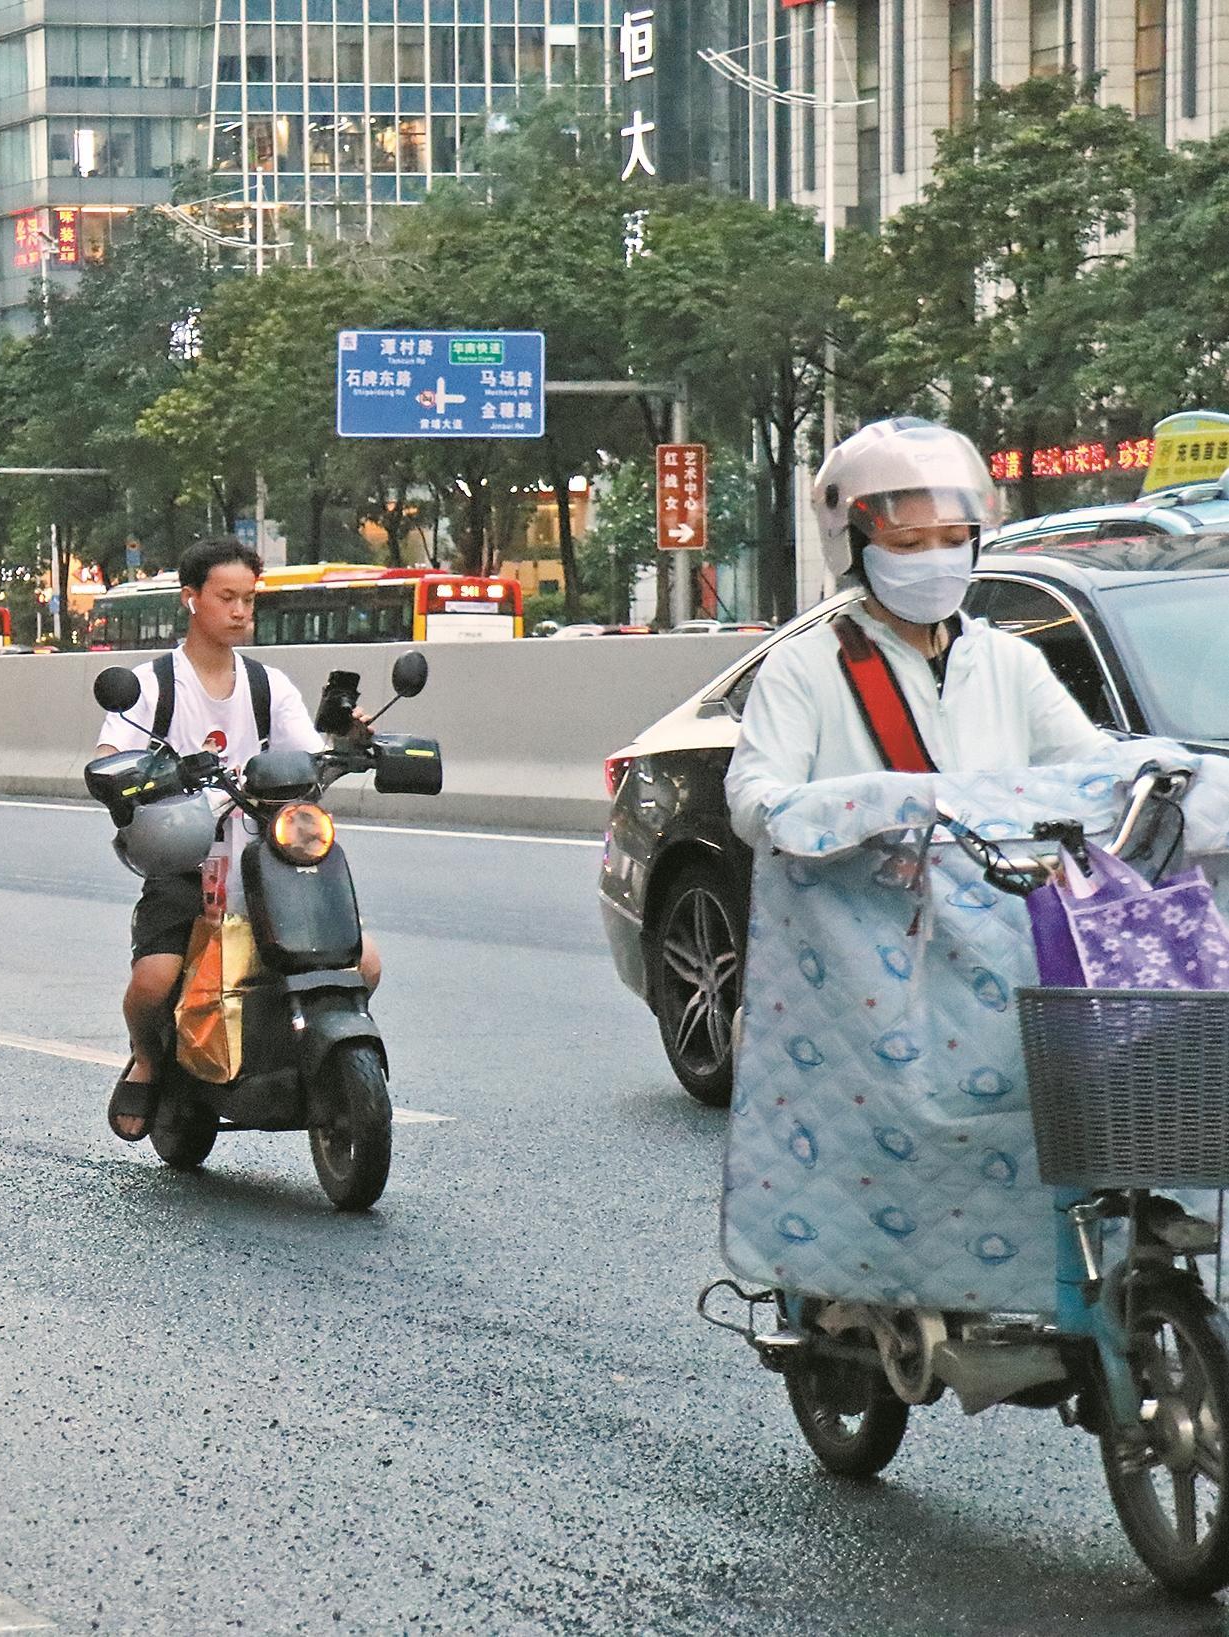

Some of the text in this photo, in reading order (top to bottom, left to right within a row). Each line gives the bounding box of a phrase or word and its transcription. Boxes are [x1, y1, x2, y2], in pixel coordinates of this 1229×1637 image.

[620, 10, 655, 268] 恒大
[380, 338, 433, 356] 潭村路
[345, 369, 412, 388] 石牌东路
[480, 370, 532, 388] 马场路
[484, 389, 530, 398] Machang Rd
[481, 402, 532, 419] 金穗路
[420, 418, 463, 431] 黄埔大道
[515, 422, 525, 430] Rd
[664, 451, 679, 511] 红线女
[684, 451, 699, 511] 艺术中心
